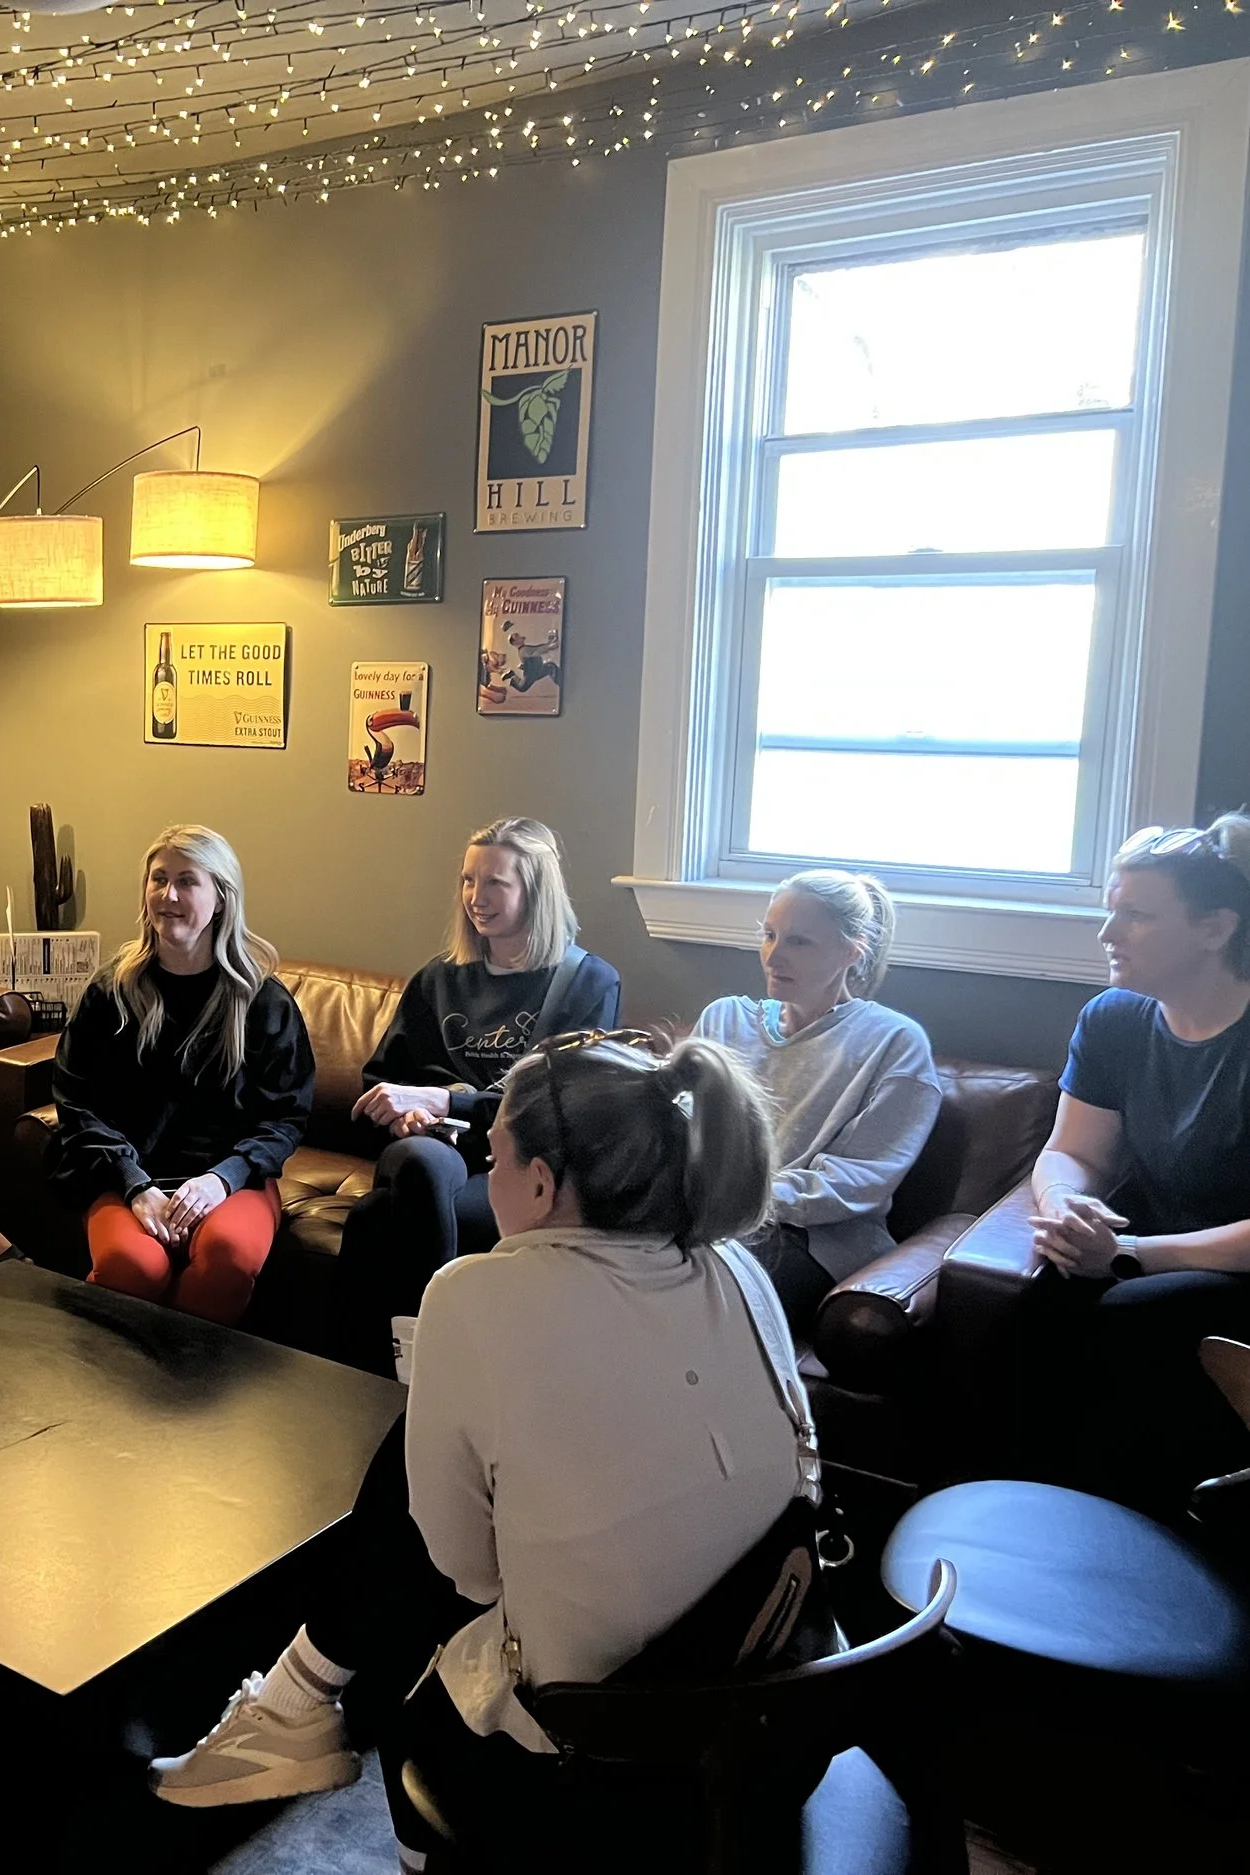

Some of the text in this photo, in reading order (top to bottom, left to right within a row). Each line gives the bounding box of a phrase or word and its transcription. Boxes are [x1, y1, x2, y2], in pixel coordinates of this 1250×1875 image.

[489, 324, 588, 371] MANOR
[486, 479, 577, 509] HILL
[487, 510, 573, 526] BREWING
[338, 524, 387, 551] Underberg
[350, 540, 393, 564] BITTER
[353, 564, 388, 579] by
[352, 579, 388, 597] NATURE
[501, 598, 560, 615] GUINNESS
[181, 644, 282, 660] LET THE GOOD
[188, 670, 272, 686] TIMES ROLL
[383, 670, 400, 683] day
[401, 670, 416, 682] for
[418, 673, 425, 681] a
[353, 688, 396, 700] GUINNESS
[242, 713, 282, 724] GUINNESS
[234, 726, 282, 738] EXTRA STOUT
[442, 1012, 528, 1051] Center
